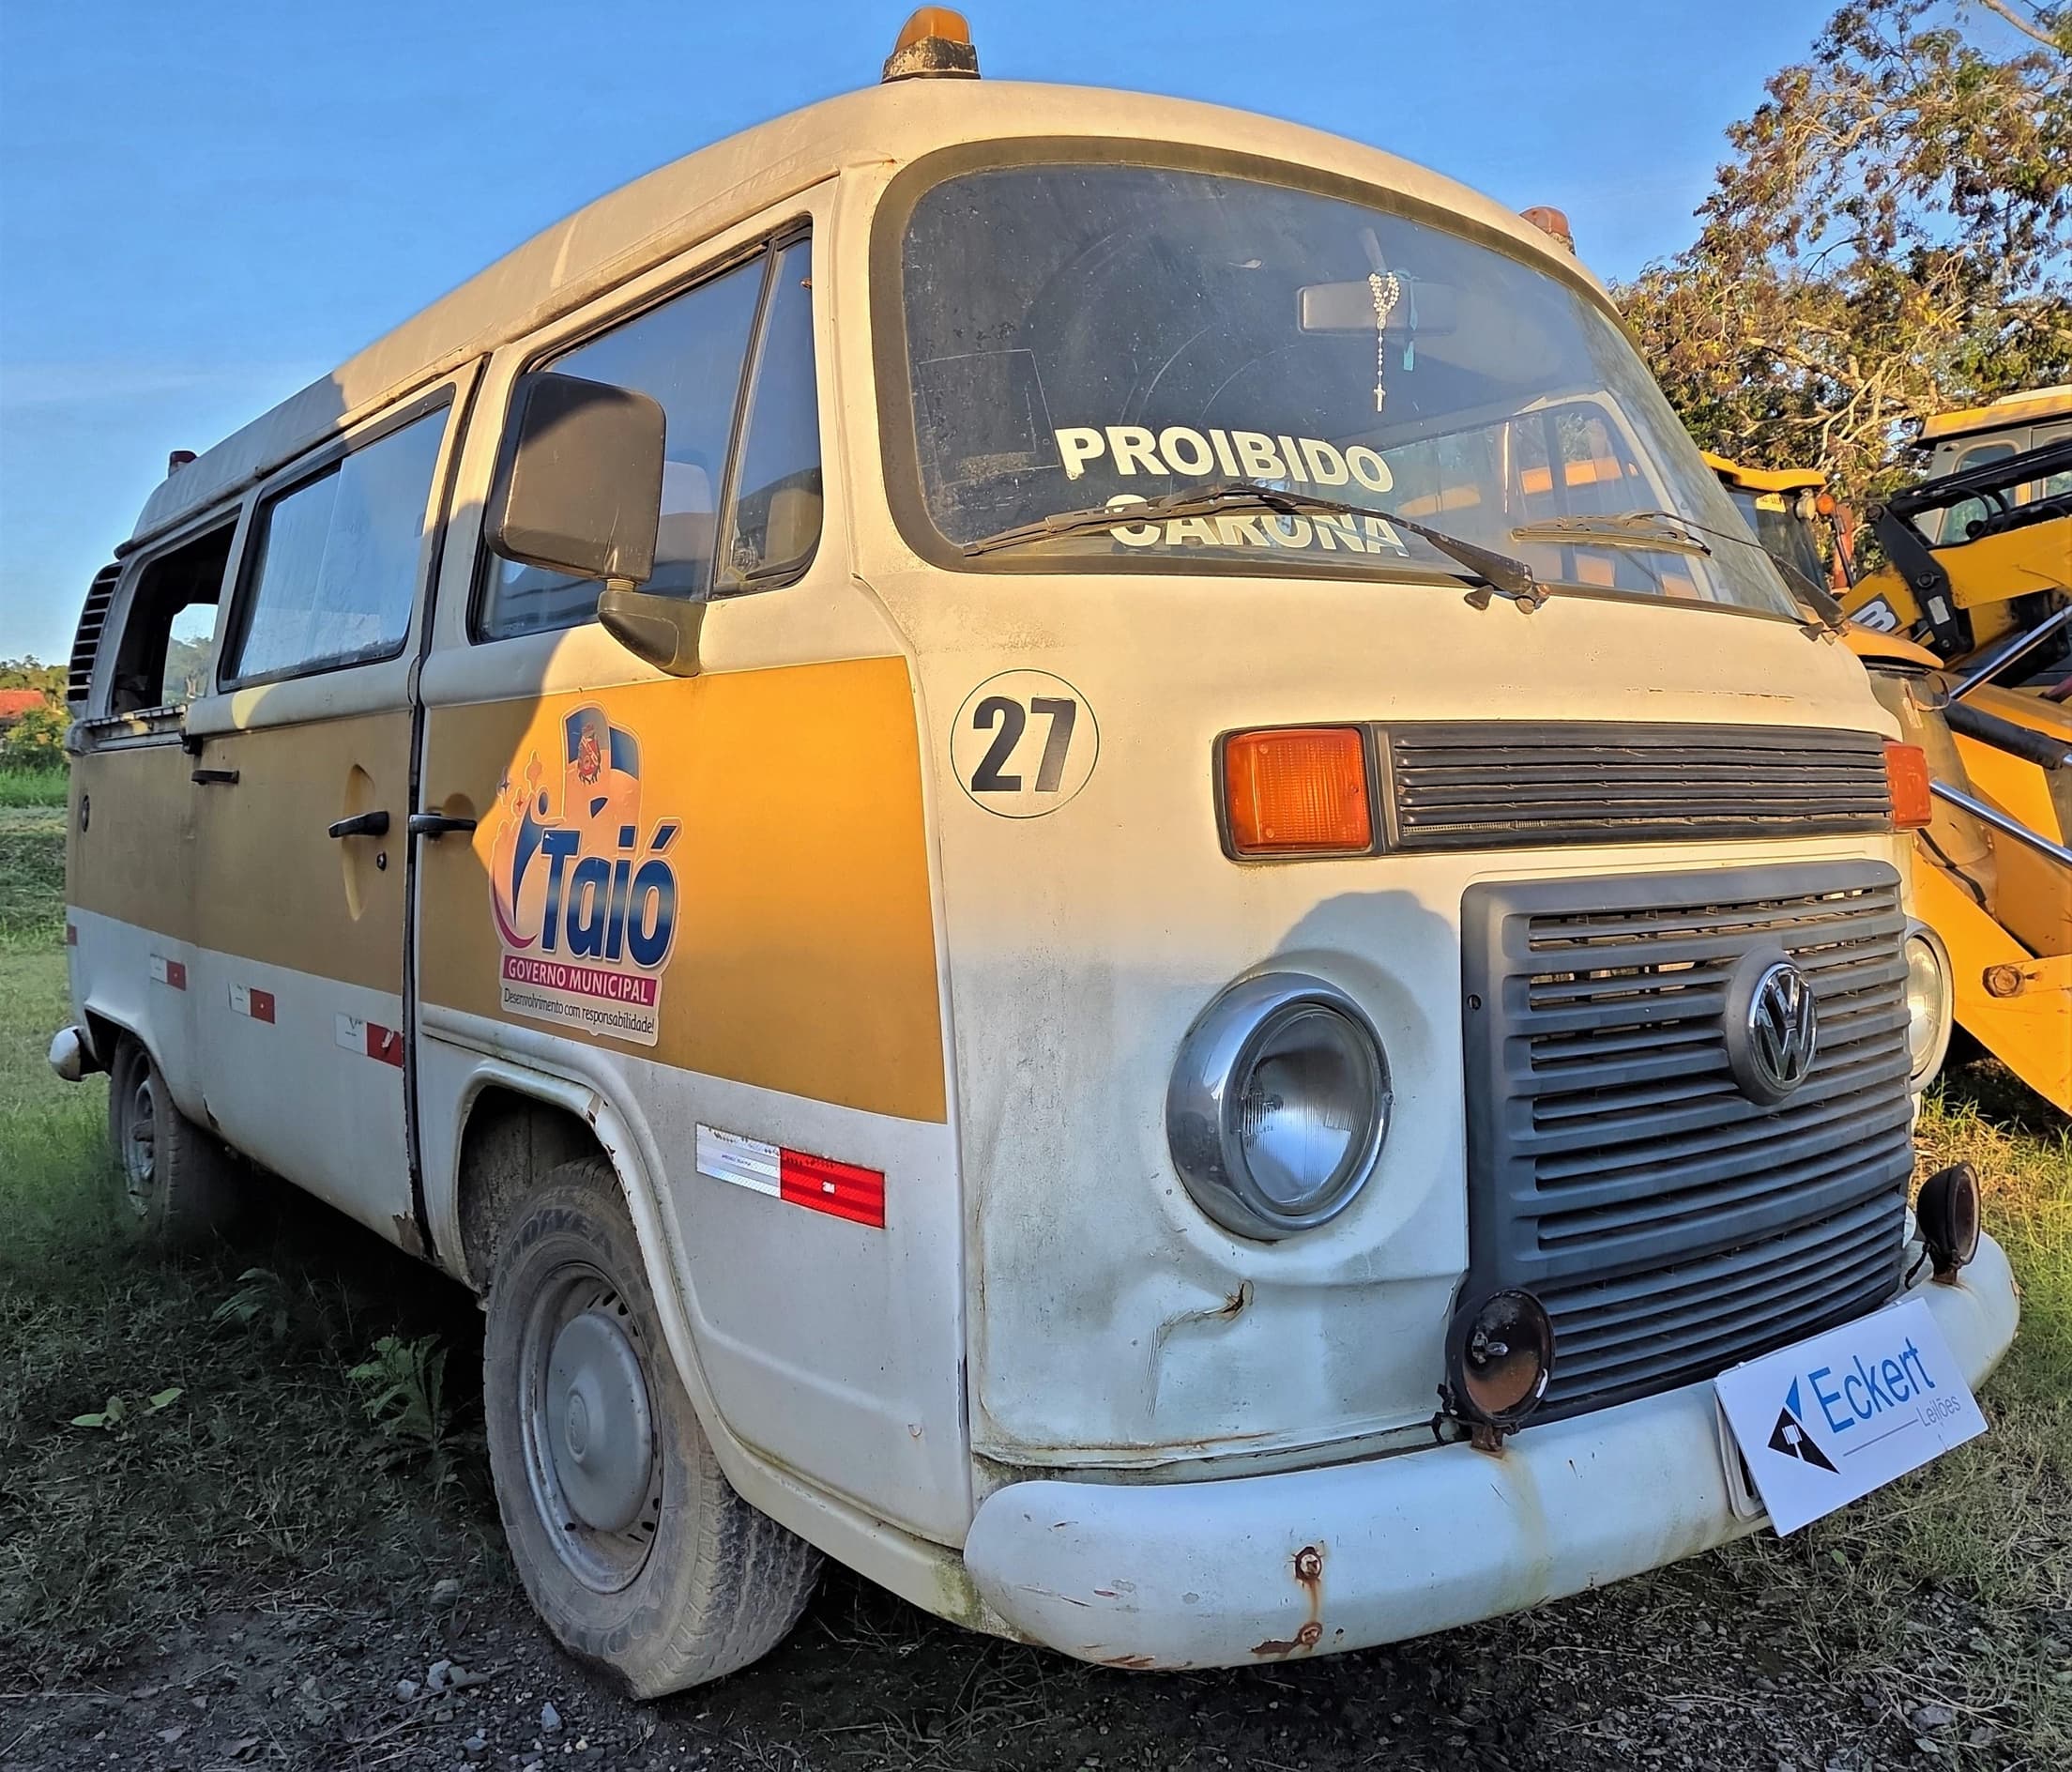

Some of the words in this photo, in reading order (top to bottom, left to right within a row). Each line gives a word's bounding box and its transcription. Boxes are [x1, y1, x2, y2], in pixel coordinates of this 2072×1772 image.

[1054, 425, 1394, 494] PROIBIDO
[1105, 494, 1410, 558] CARONA
[971, 695, 1077, 793] 27
[541, 824, 678, 968] Taió
[504, 988, 563, 1014] Desenvolvimento
[564, 1003, 581, 1019] com
[582, 1007, 654, 1034] responsabilidade!
[508, 958, 567, 986] GOVERNO
[569, 969, 648, 1003] MUNICIPAL
[1807, 1336, 1936, 1434] Eckert
[1915, 1395, 1962, 1428] Leilões
